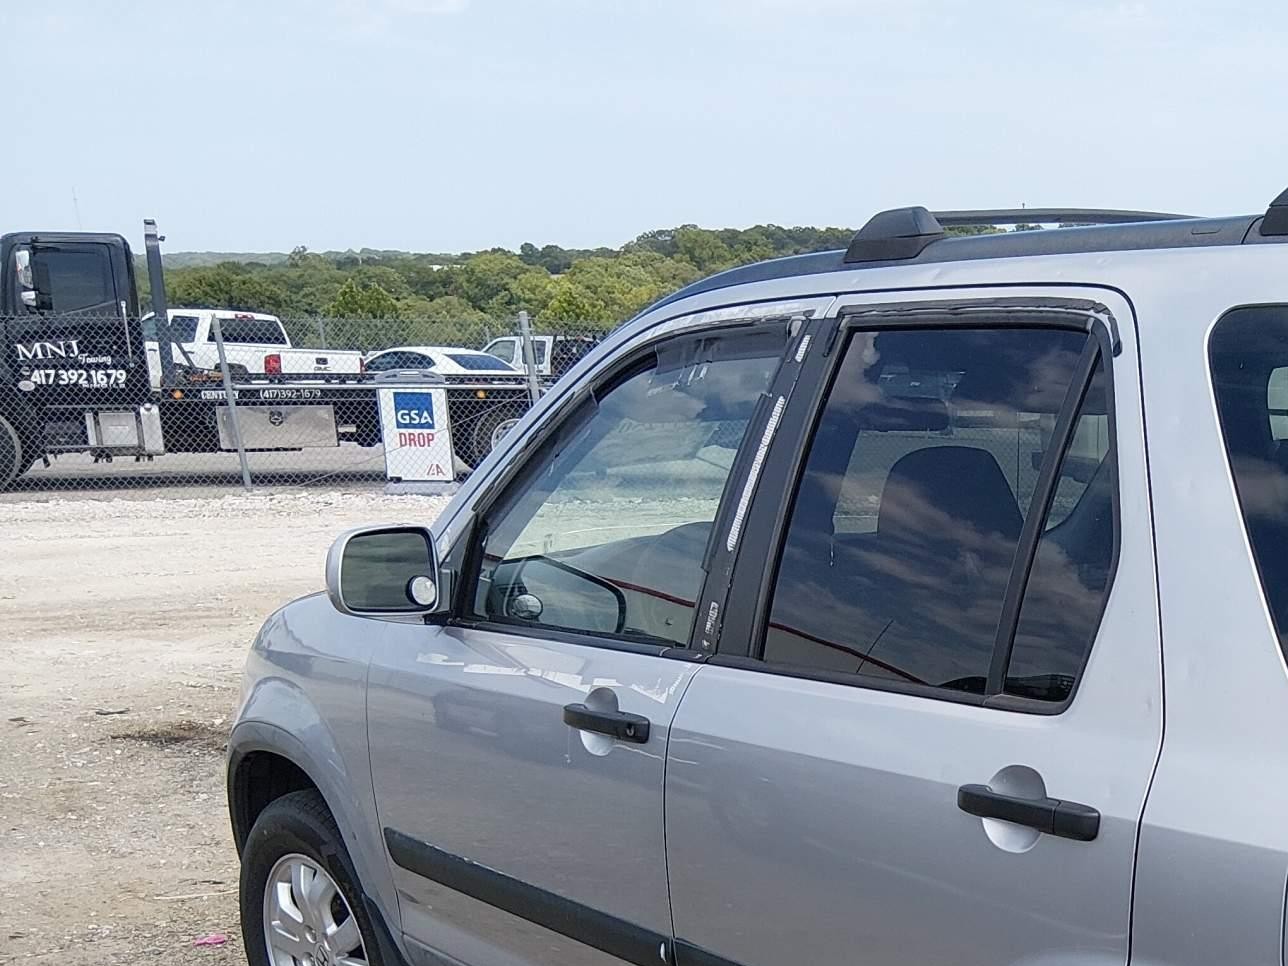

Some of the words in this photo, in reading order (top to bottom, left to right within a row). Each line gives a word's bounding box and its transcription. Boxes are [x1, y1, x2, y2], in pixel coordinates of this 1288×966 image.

[15, 340, 80, 360] MNJ
[78, 353, 112, 366] Towing
[30, 369, 56, 385] 417
[58, 369, 88, 385] 392
[90, 369, 127, 385] 1679
[397, 410, 433, 425] GSA
[399, 432, 434, 448] DROP
